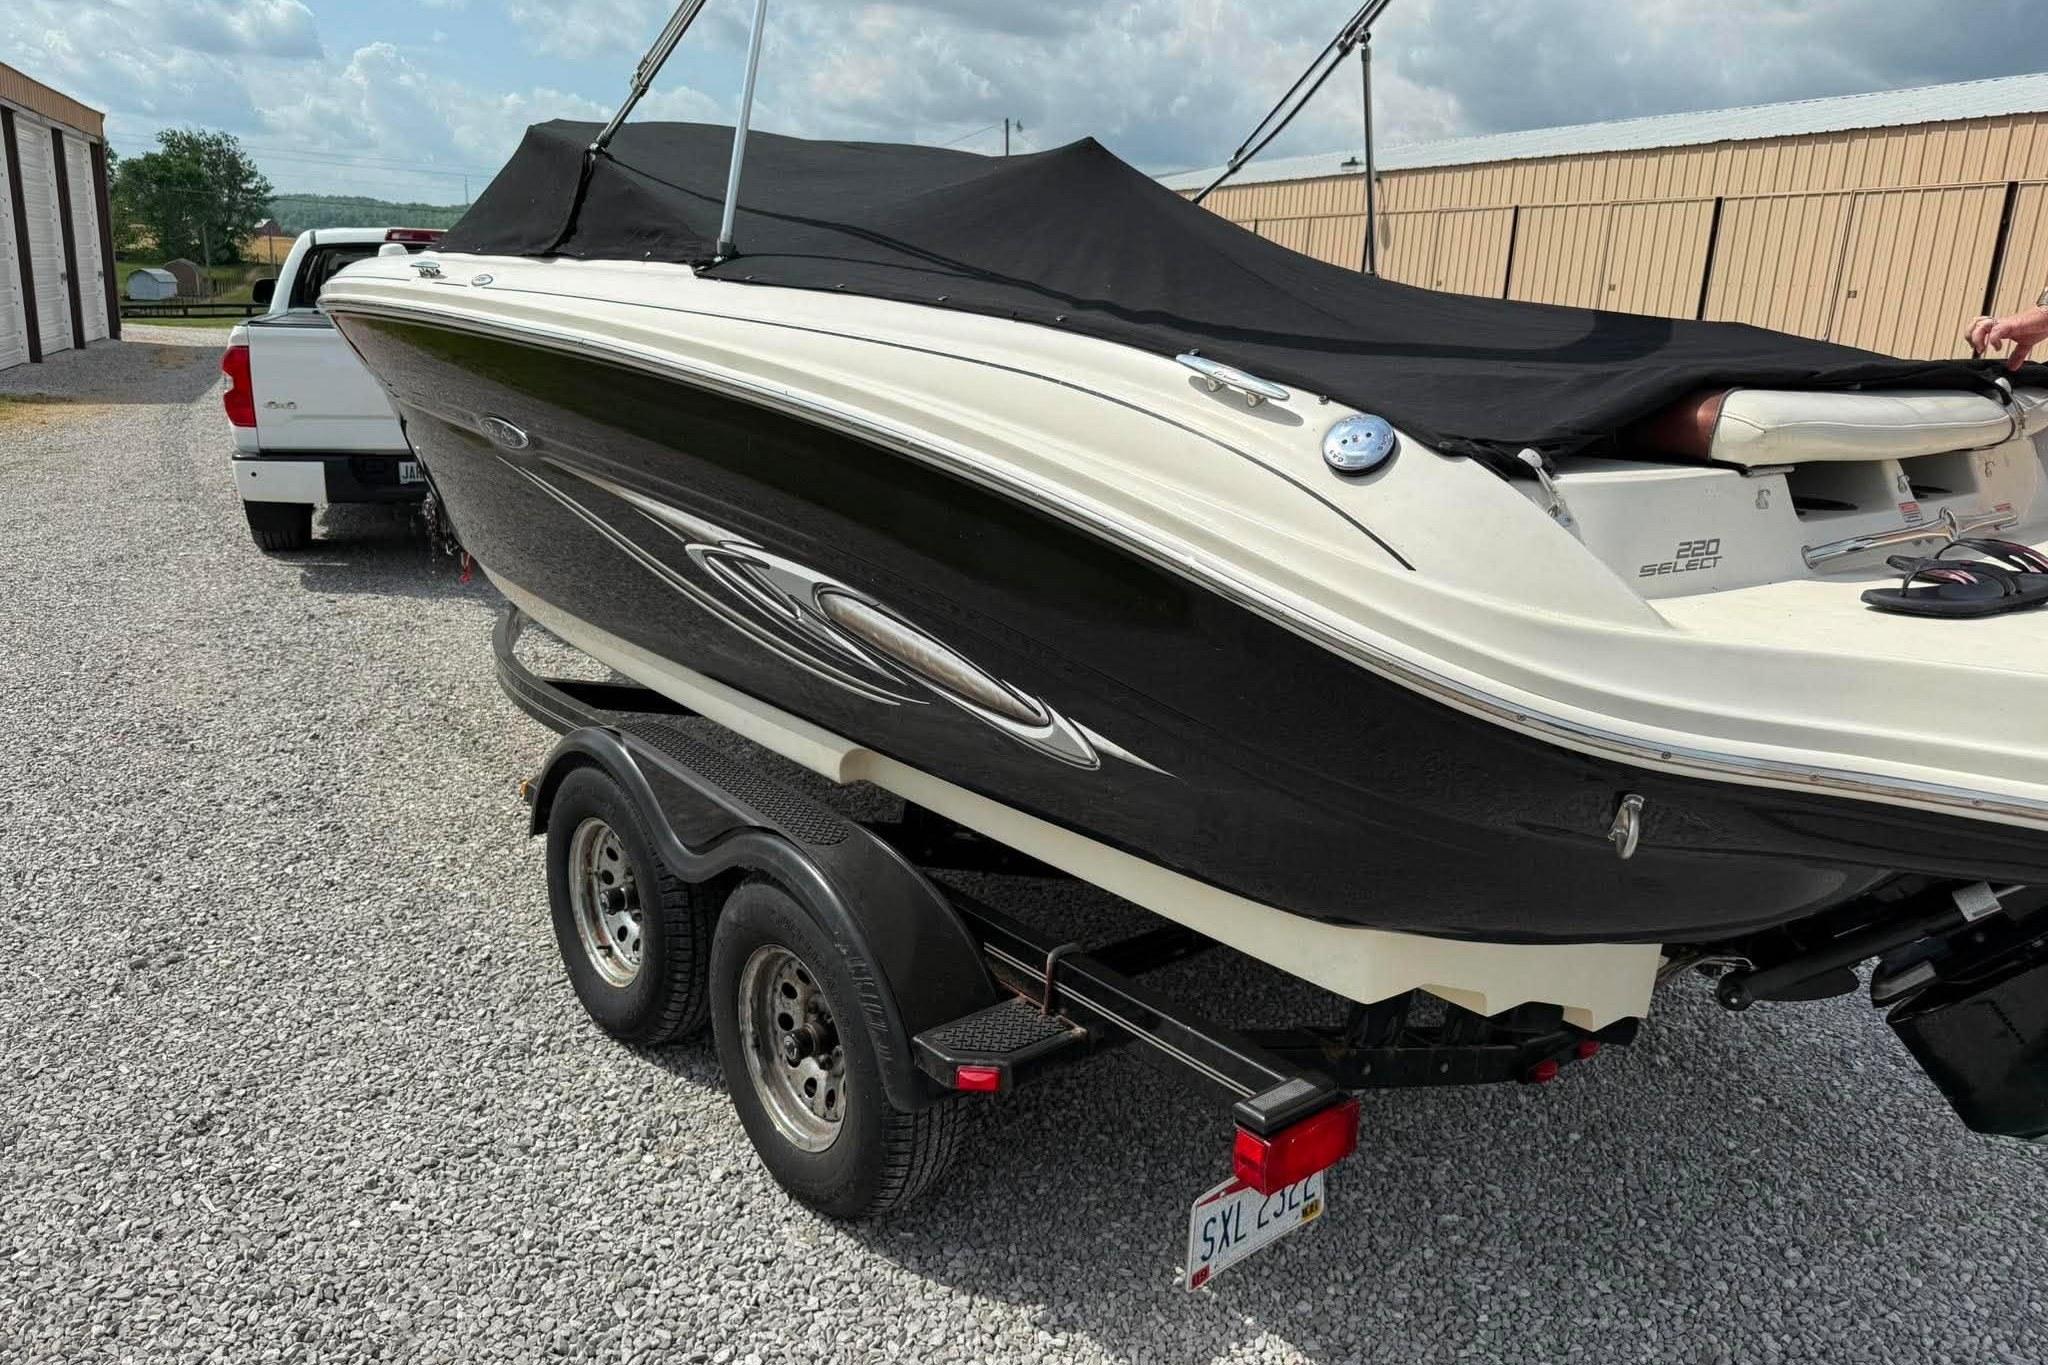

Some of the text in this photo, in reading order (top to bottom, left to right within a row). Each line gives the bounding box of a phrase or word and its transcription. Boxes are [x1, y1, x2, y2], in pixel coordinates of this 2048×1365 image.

[1676, 538, 1721, 559] 220
[1638, 556, 1722, 577] SELECT
[1200, 1200, 1247, 1262] SXL
